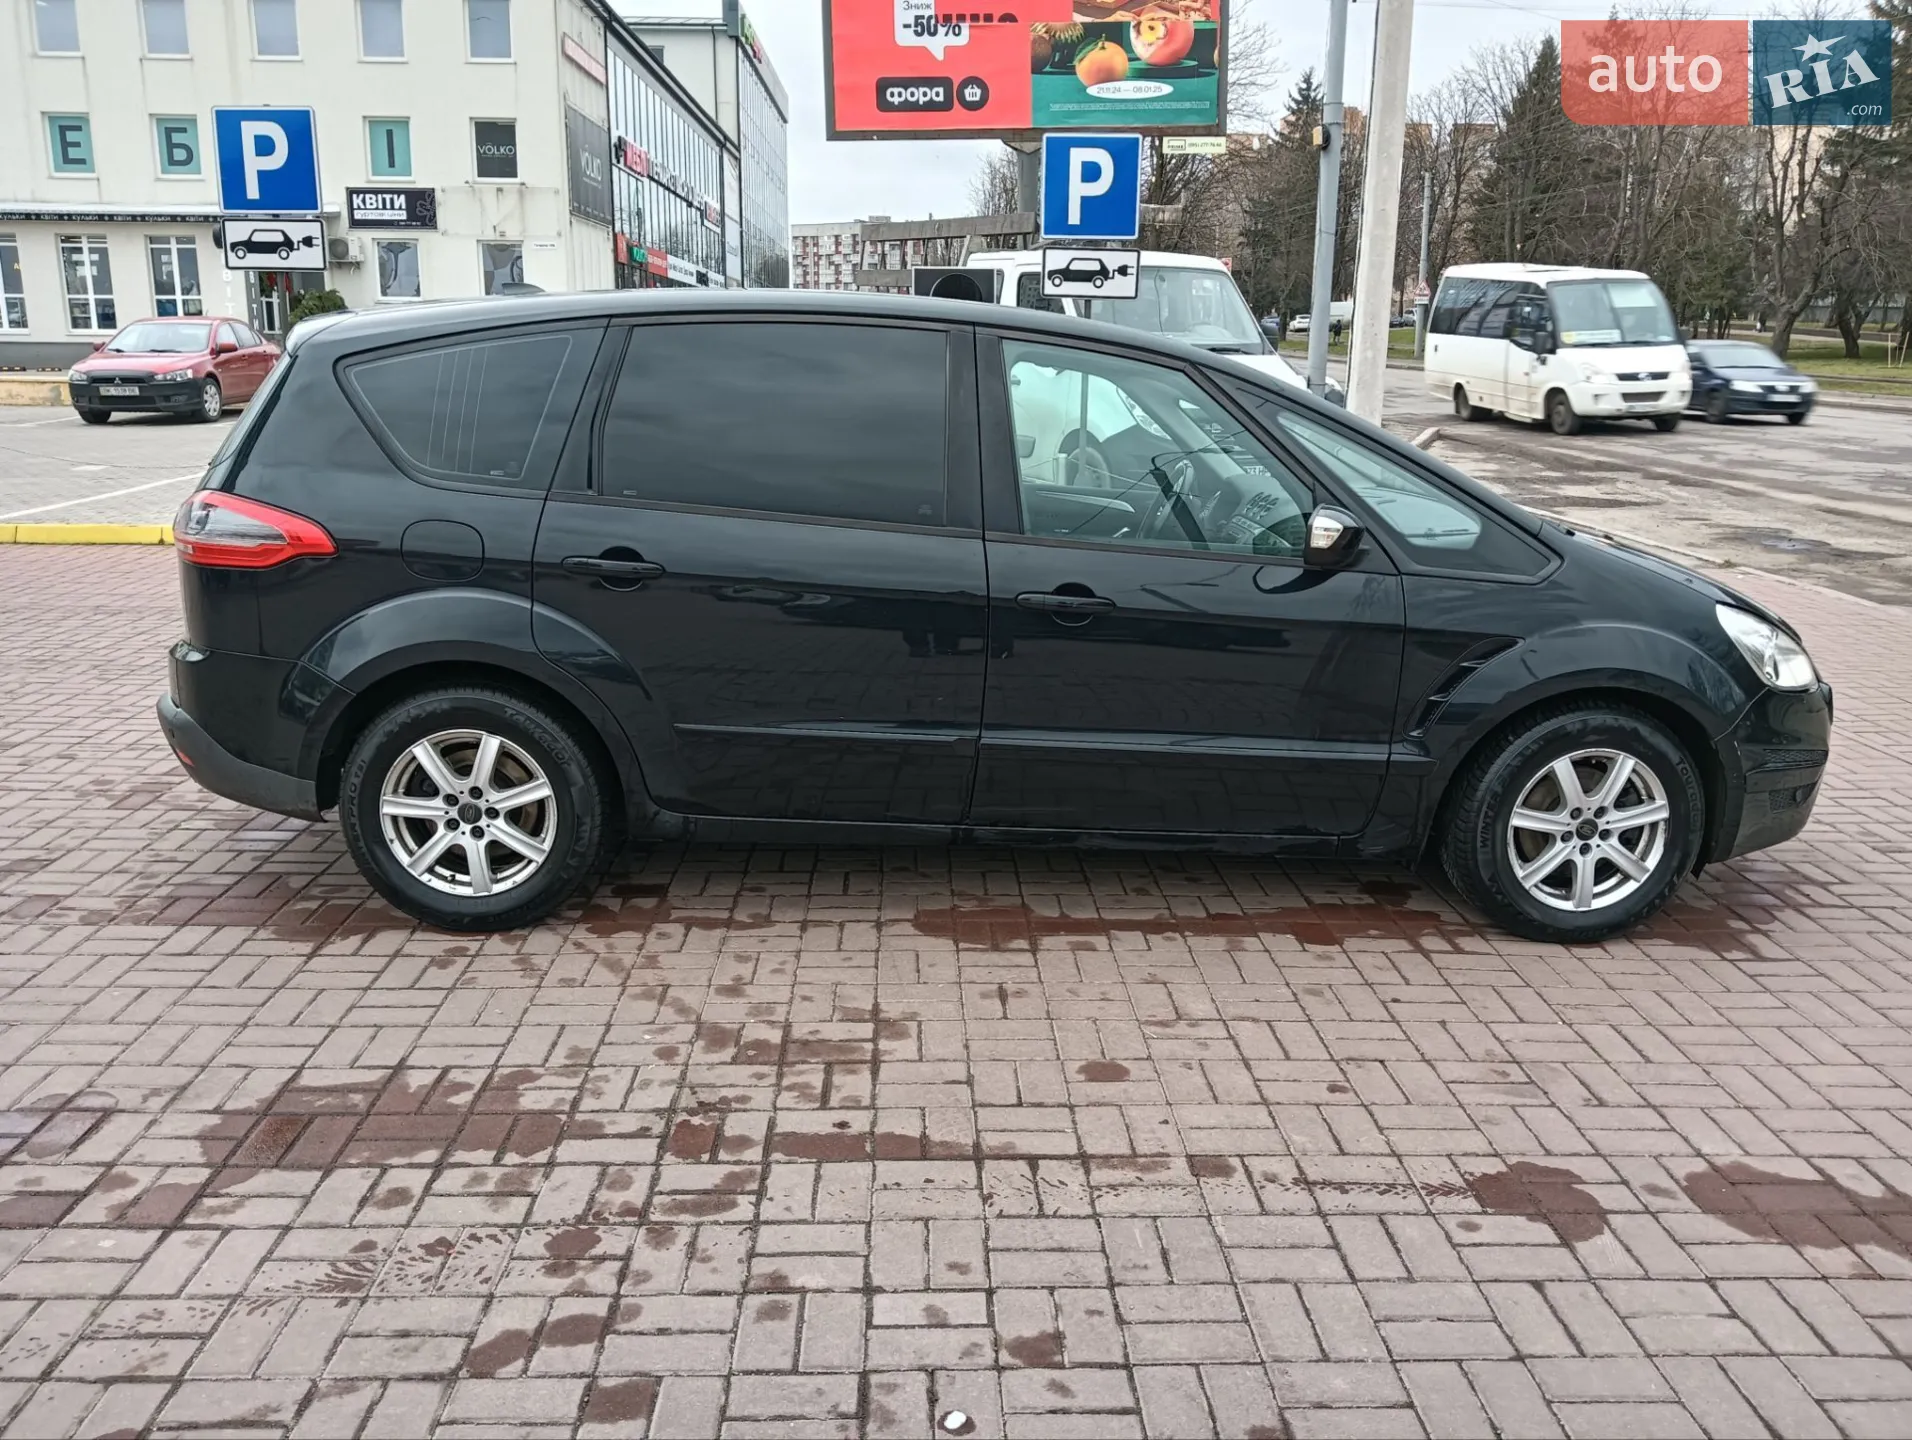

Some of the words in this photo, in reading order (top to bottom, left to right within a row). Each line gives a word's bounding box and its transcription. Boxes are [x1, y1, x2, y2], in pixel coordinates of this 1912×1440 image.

[886, 87, 944, 105] фора
[240, 121, 289, 199] P
[352, 193, 406, 209] КВІТИ
[1067, 147, 1114, 225] P
